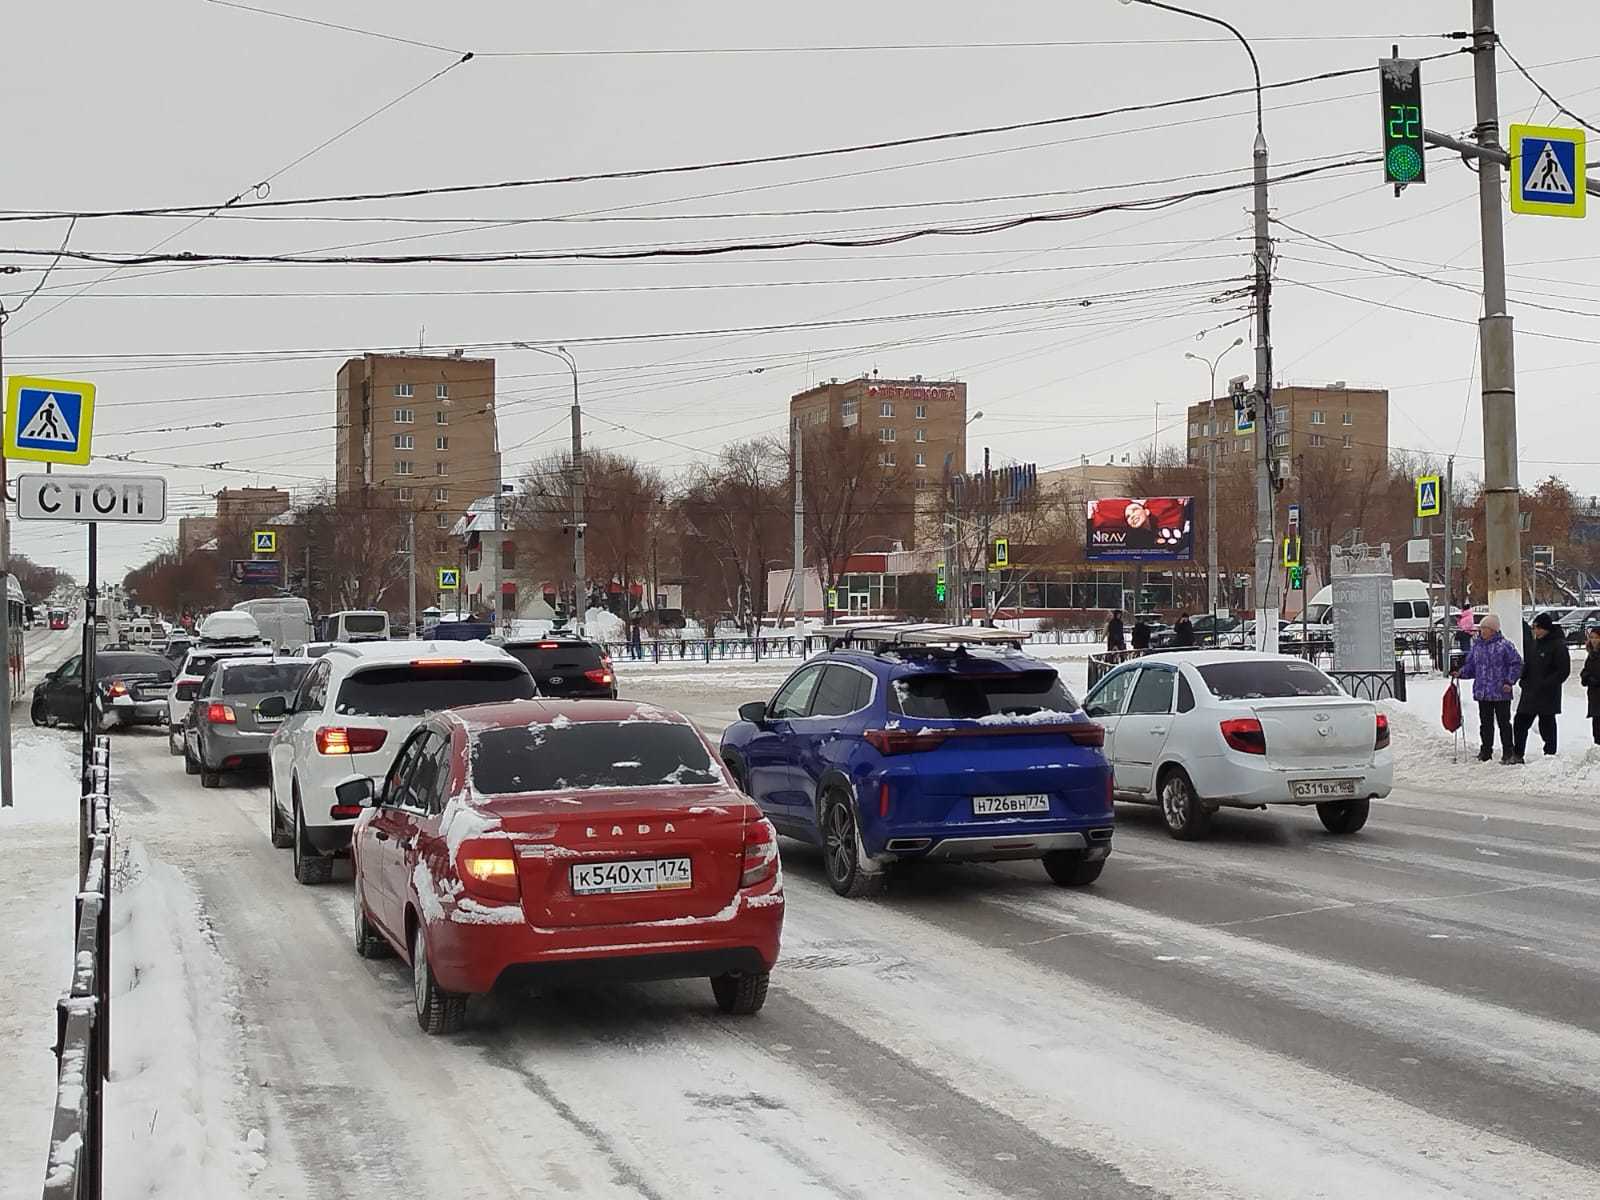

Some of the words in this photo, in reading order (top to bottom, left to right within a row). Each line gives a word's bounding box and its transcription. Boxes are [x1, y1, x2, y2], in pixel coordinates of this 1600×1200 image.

[1390, 105, 1419, 138] 22
[38, 482, 144, 514] СТОП
[586, 823, 676, 838] LADA
